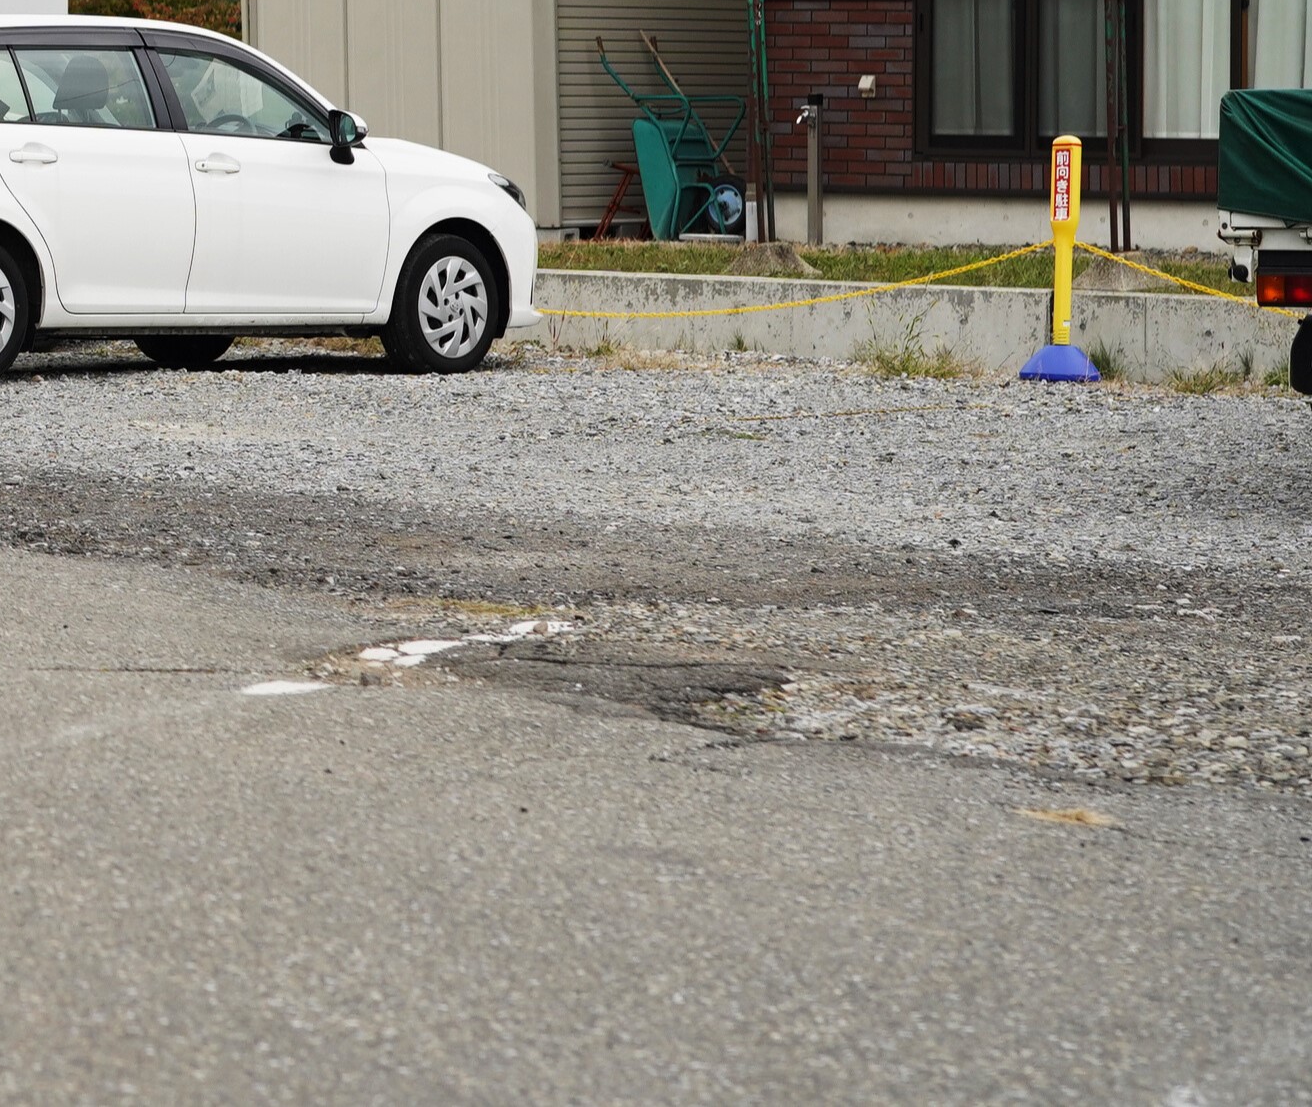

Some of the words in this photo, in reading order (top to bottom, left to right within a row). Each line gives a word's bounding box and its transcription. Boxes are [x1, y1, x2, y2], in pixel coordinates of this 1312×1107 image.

[1055, 151, 1069, 221] 前向き駐車
